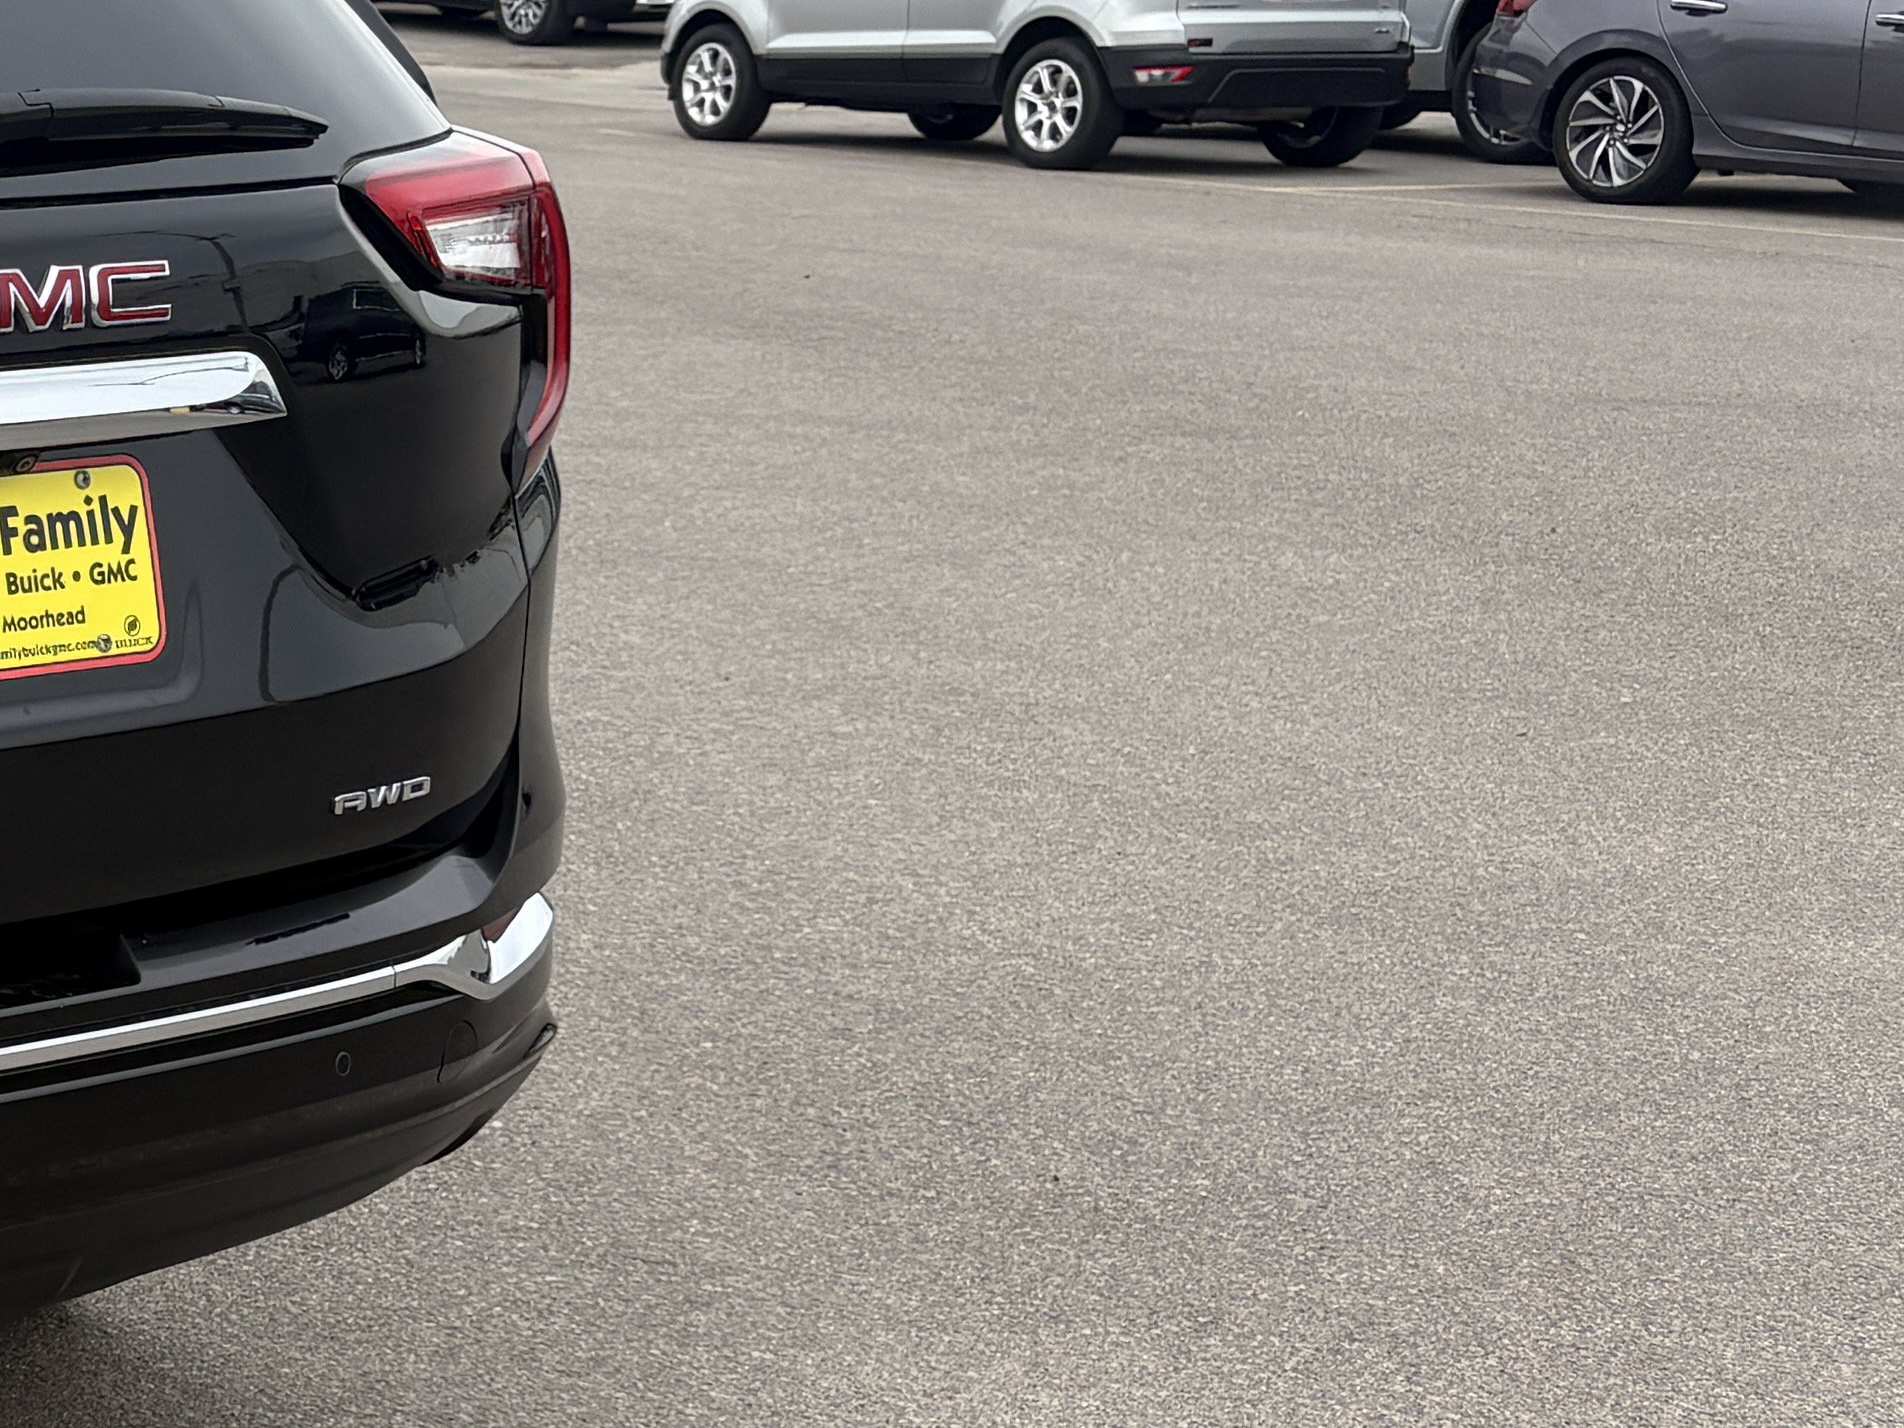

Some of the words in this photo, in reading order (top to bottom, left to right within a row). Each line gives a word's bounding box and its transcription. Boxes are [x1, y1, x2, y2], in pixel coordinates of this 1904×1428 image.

[5, 567, 66, 596] Buick
[89, 558, 139, 586] GMC
[2, 605, 87, 634] Moorhead
[333, 775, 432, 815] AWD
